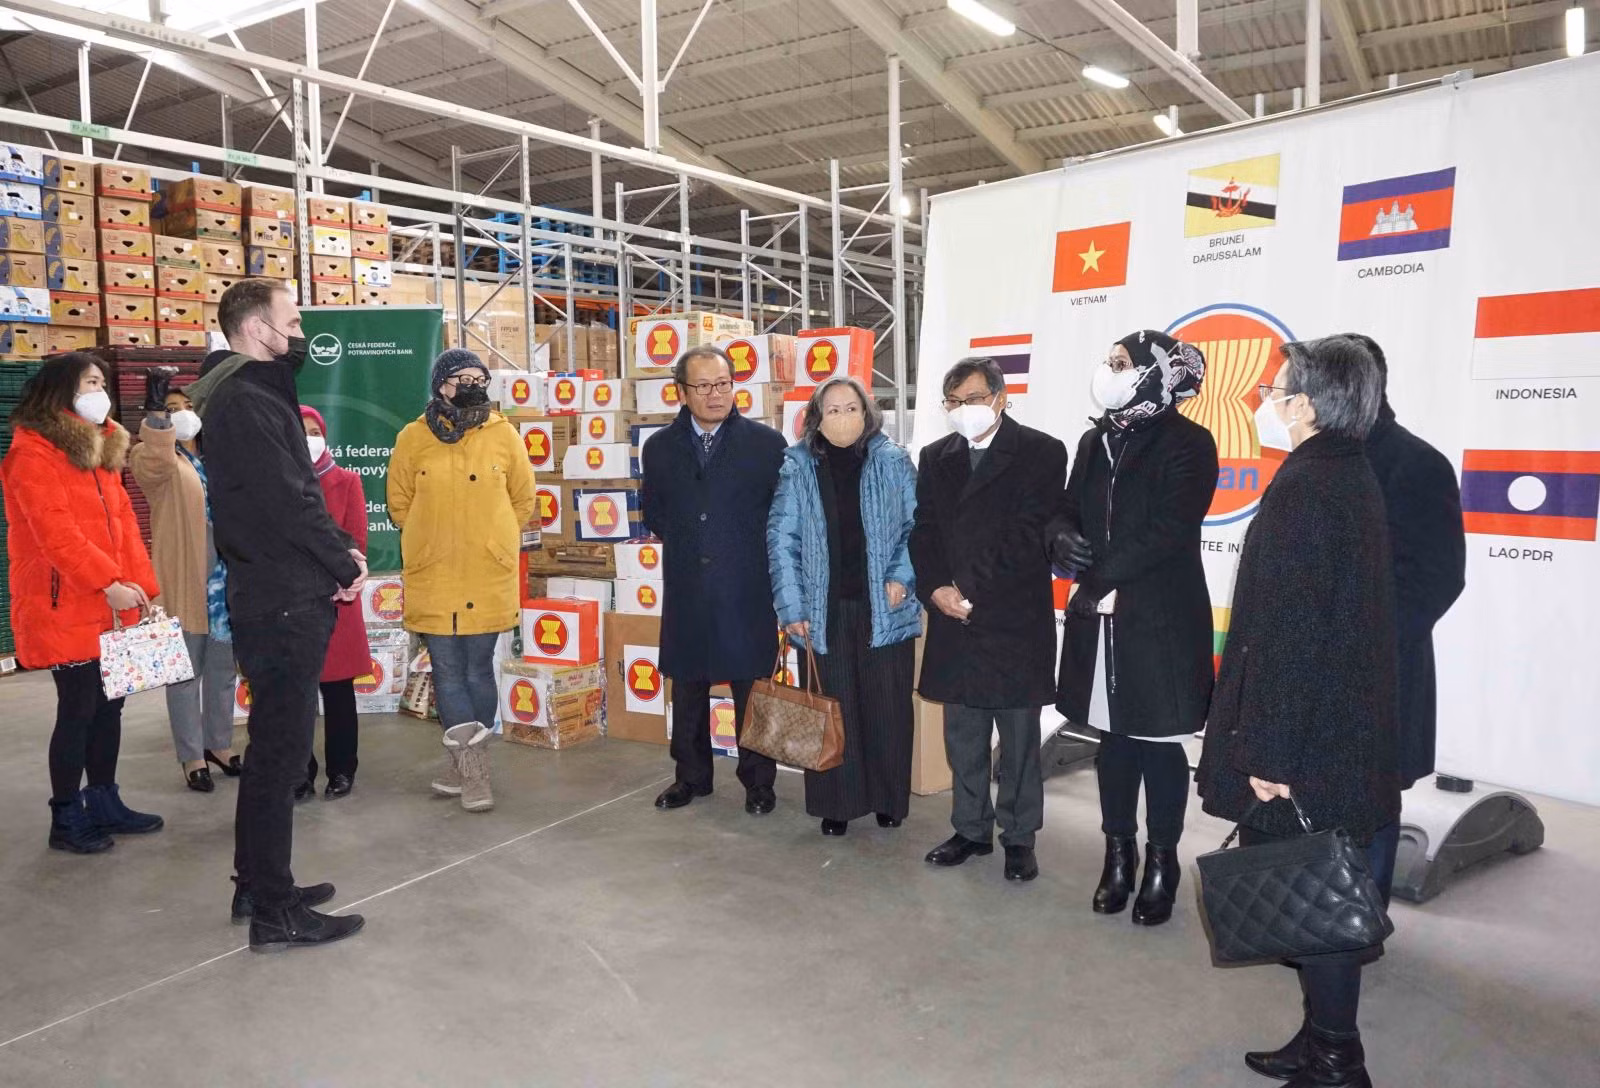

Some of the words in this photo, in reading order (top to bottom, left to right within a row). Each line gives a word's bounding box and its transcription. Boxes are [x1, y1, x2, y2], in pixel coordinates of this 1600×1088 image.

[1209, 234, 1245, 248] BRUNEI
[1192, 246, 1262, 264] DARUSSALAM
[1357, 262, 1425, 279] CAMBODIA
[1070, 294, 1107, 306] VIETNAM
[347, 341, 367, 349] ČESKÁ
[367, 341, 397, 349] FEDERACE
[1495, 387, 1578, 400] INDONESIA
[340, 463, 389, 479] inový
[366, 518, 400, 531] anks
[1228, 542, 1240, 553] IN
[1489, 546, 1520, 560] LAO
[1522, 548, 1554, 562] PDR
